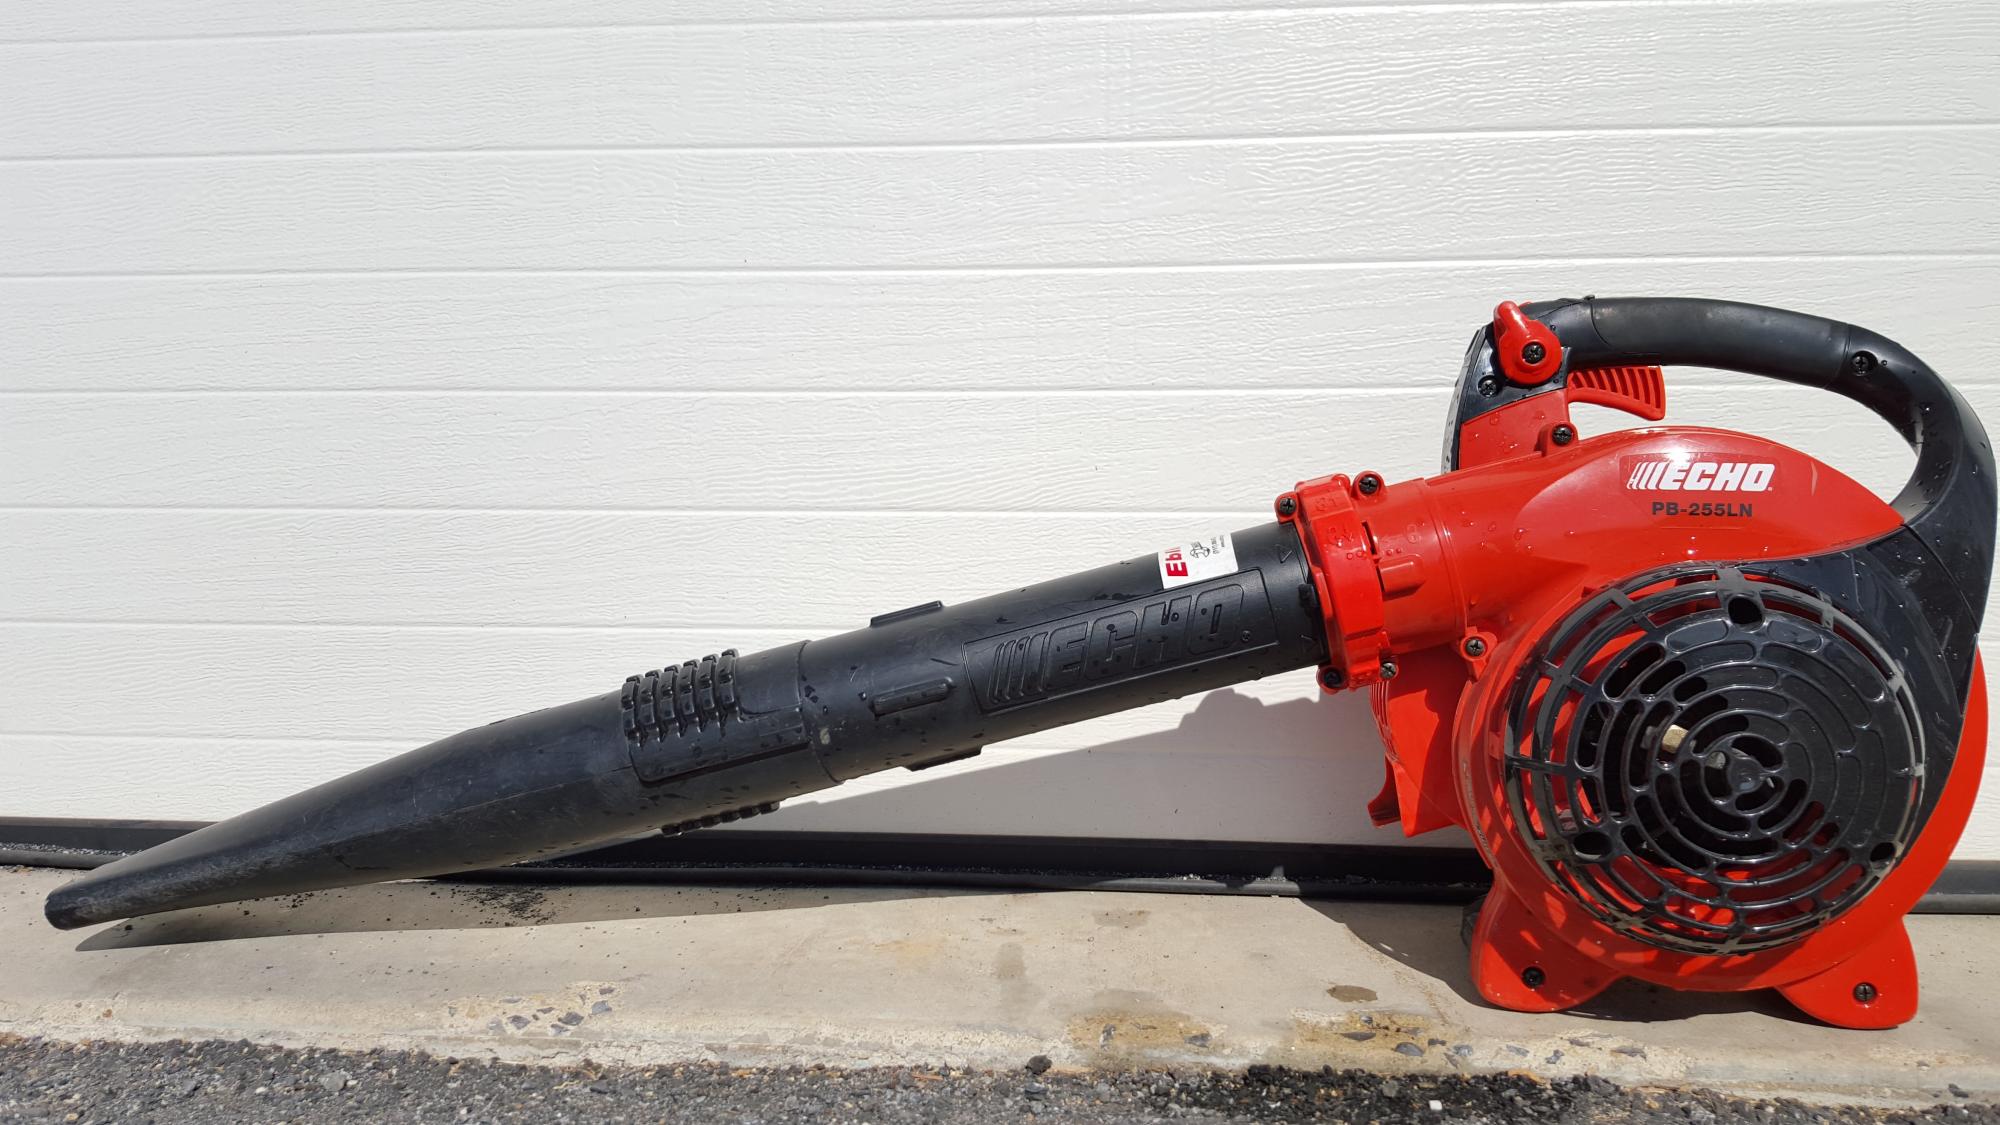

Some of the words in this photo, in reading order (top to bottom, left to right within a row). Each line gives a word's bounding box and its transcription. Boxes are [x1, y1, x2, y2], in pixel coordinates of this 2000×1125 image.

[1656, 461, 1776, 492] ECHO
[1652, 502, 1753, 517] PB-255LN
[1040, 583, 1245, 692] ECHO
